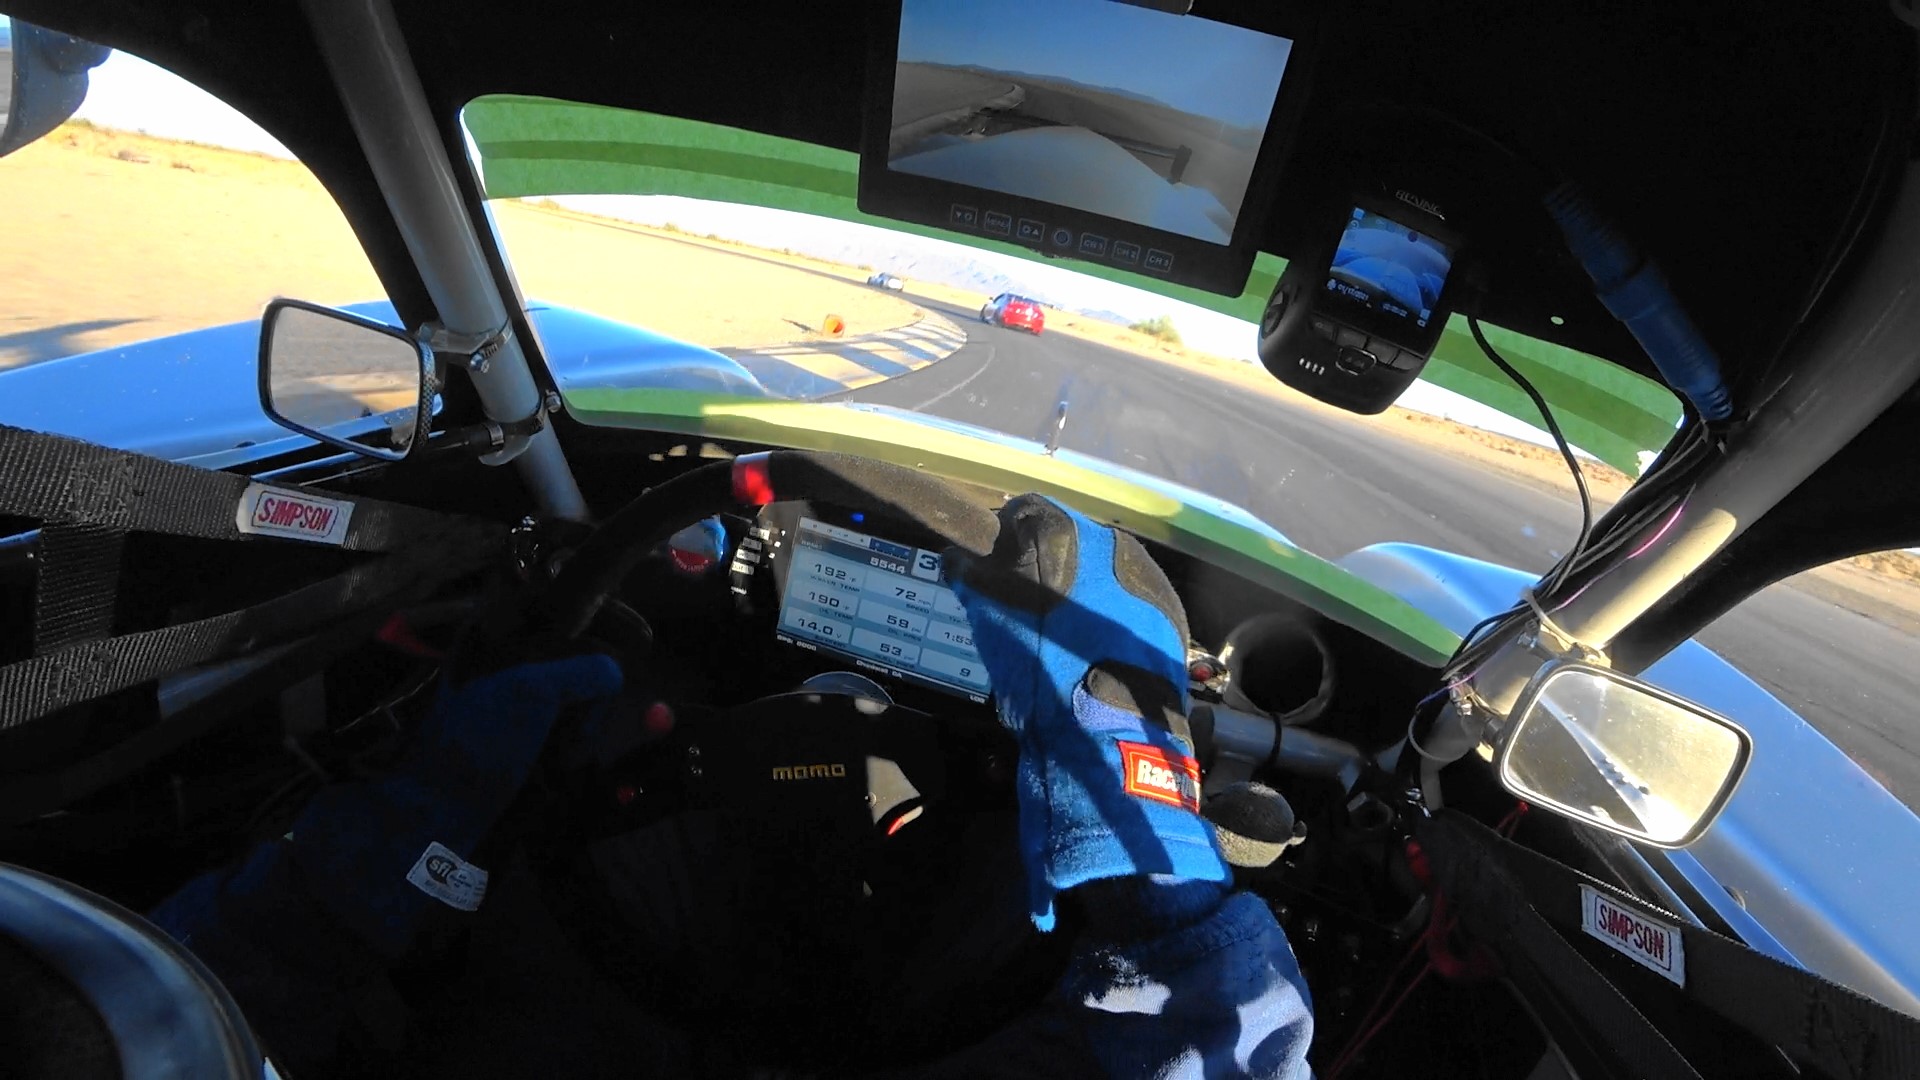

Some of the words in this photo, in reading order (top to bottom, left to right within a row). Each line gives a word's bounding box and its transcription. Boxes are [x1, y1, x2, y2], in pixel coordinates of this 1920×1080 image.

[258, 498, 333, 532] SIMPSON
[870, 557, 905, 574] 5544
[919, 553, 938, 571] 3
[815, 563, 847, 581] 192
[809, 591, 840, 608] 190
[895, 587, 916, 601] 72
[798, 618, 833, 636] 14.0
[959, 668, 971, 677] 9
[1599, 903, 1664, 962] SIMPSON
